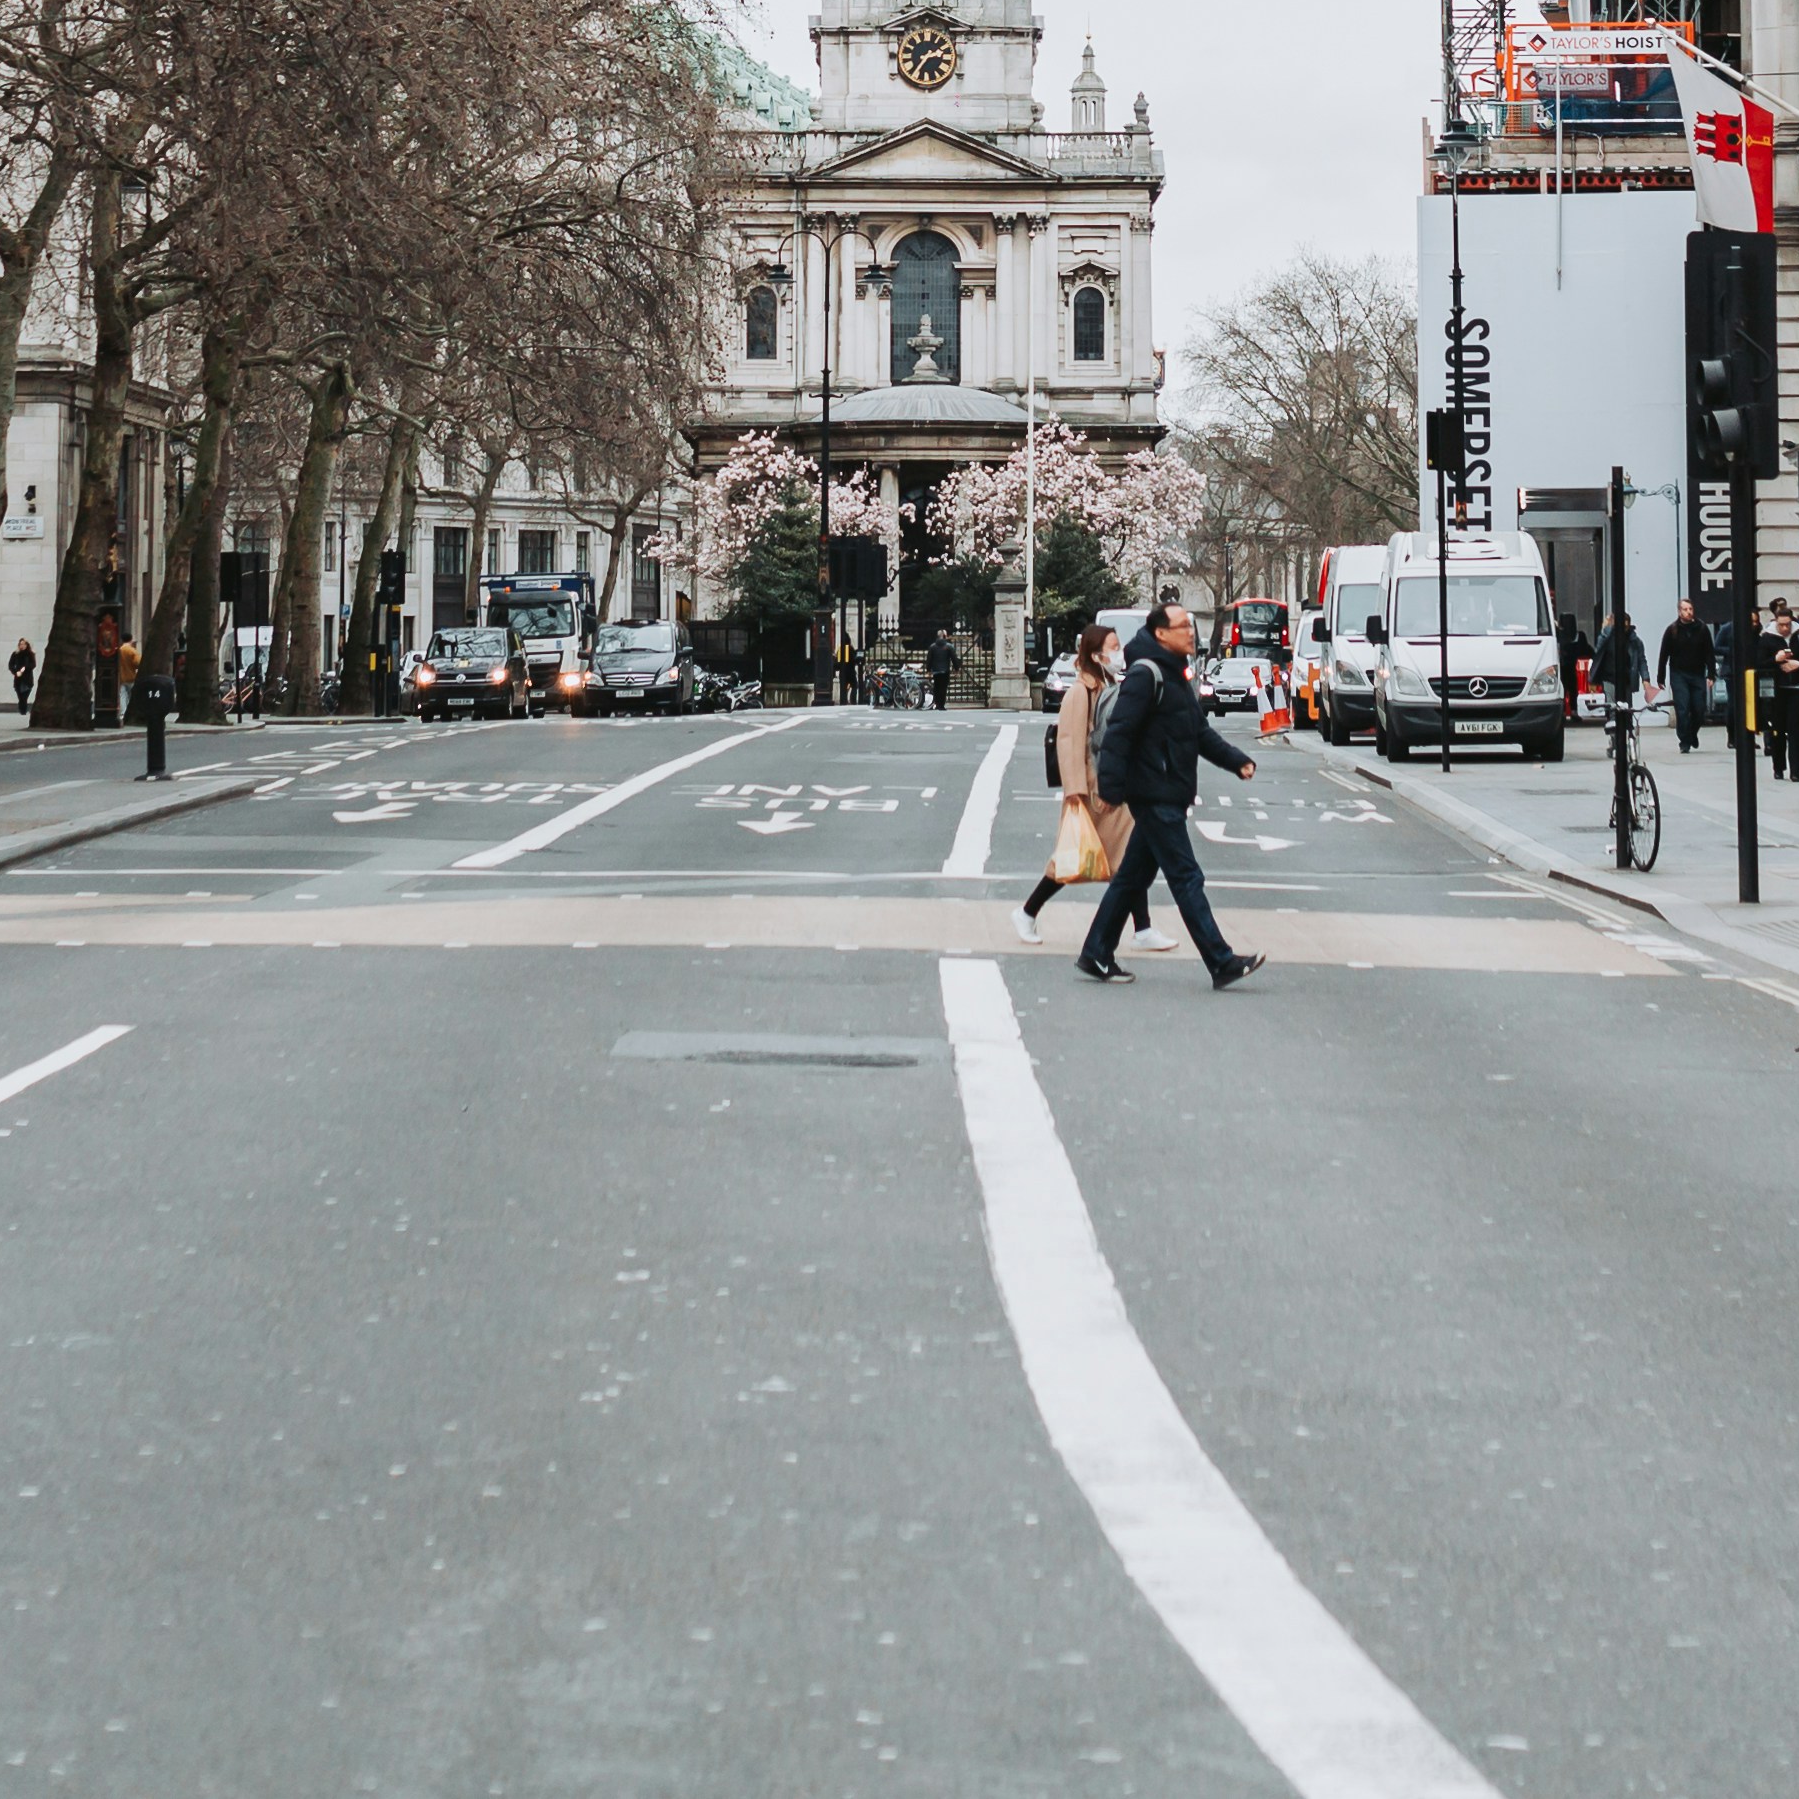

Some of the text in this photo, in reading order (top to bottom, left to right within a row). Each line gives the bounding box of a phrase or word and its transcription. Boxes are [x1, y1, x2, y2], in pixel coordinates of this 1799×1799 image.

[1550, 36, 1670, 49] TAYLOR'S HOIST
[1545, 72, 1607, 86] TAYLOR'S
[148, 689, 161, 699] 14
[670, 784, 938, 798] LANE
[695, 798, 899, 812] BUS
